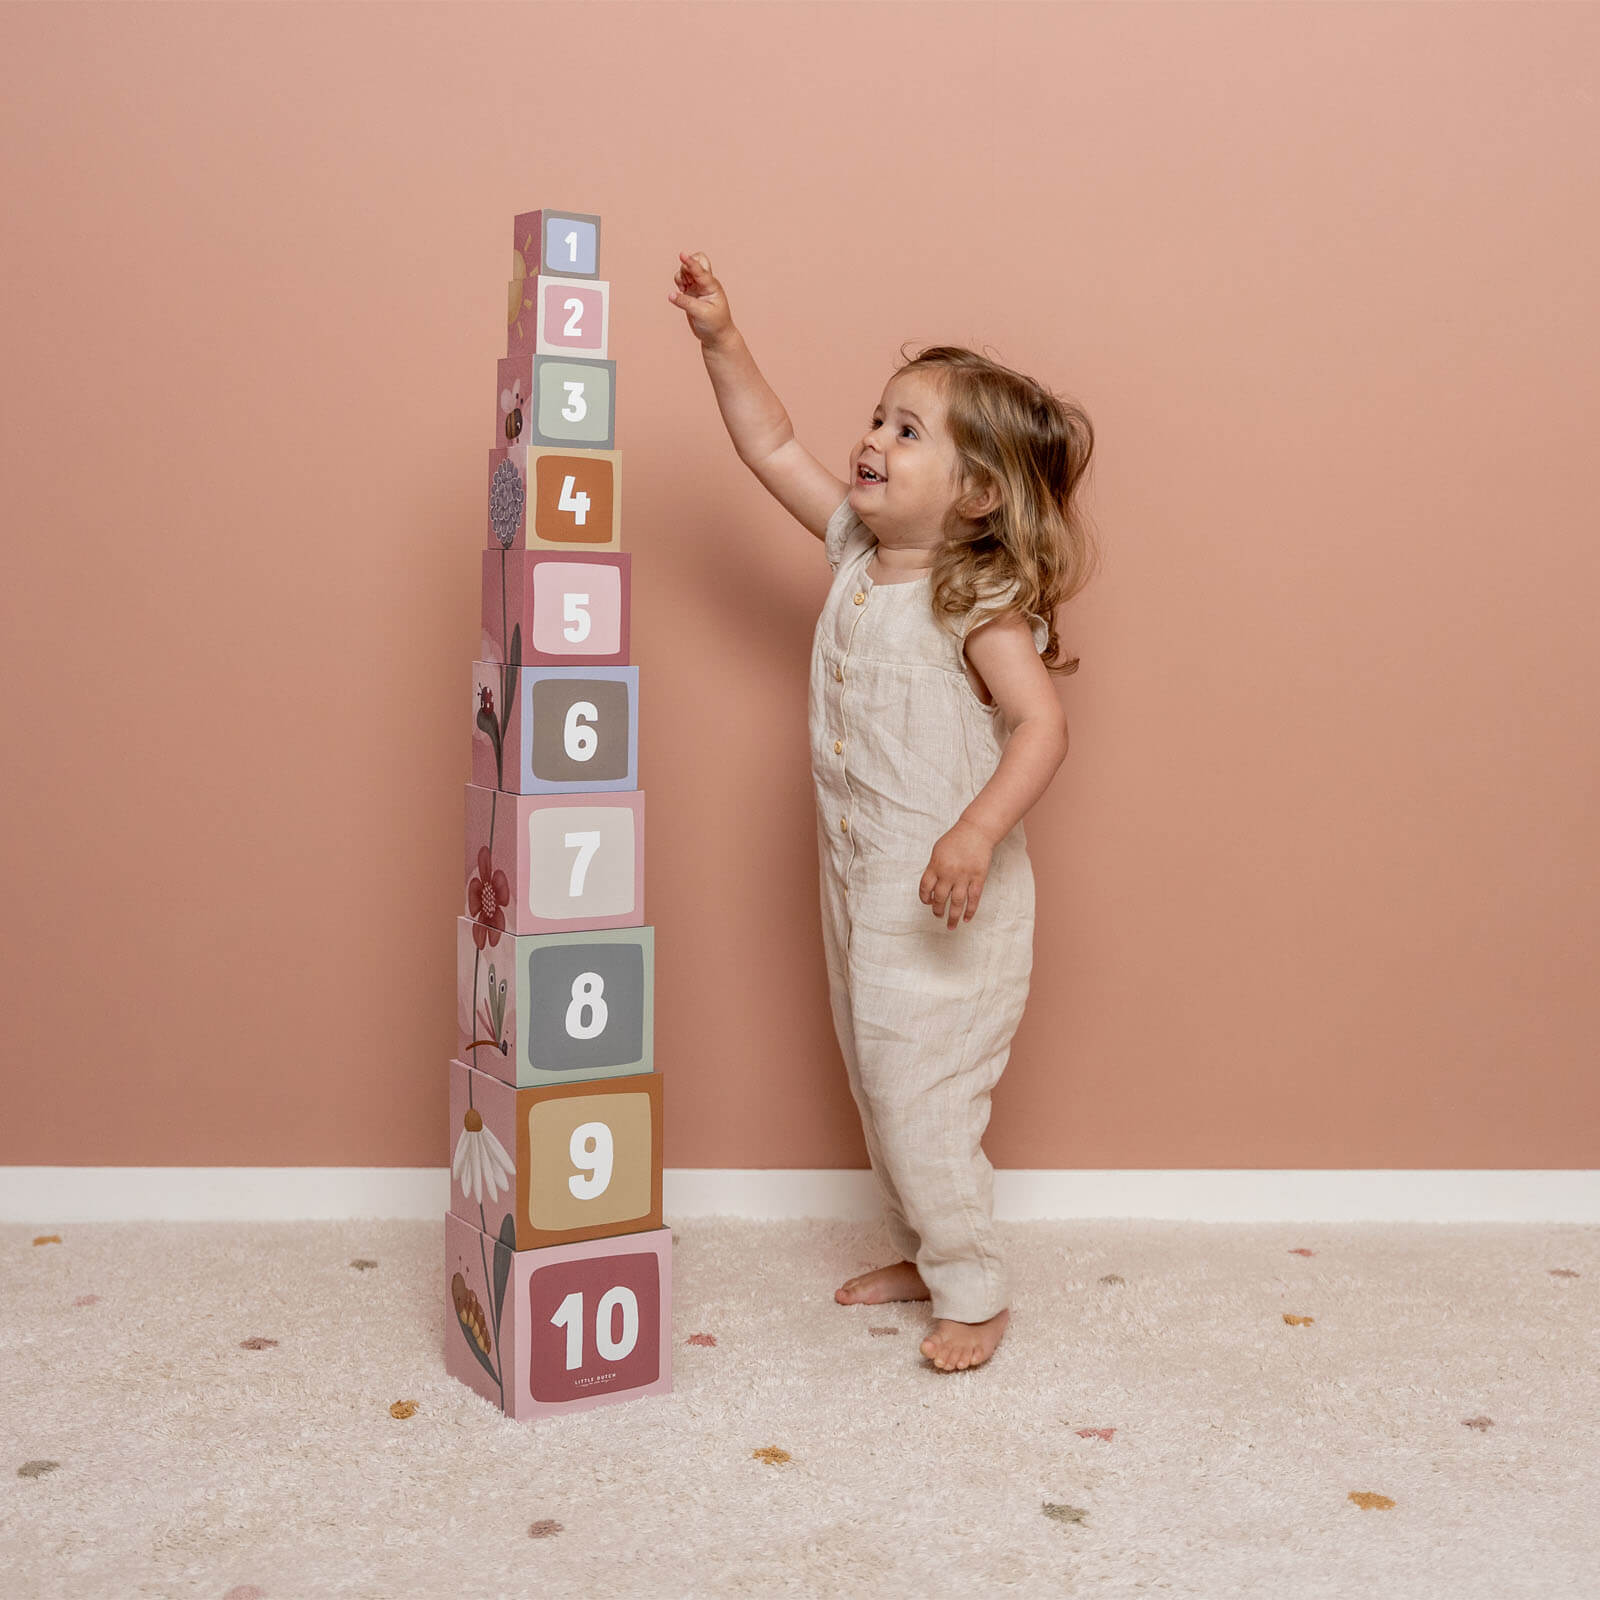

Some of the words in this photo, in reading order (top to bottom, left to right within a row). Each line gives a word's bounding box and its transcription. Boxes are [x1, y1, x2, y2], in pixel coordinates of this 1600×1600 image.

[563, 231, 578, 262] 1
[563, 298, 584, 337] 2
[561, 381, 587, 422] 3
[557, 475, 591, 526] 4
[563, 593, 592, 643] 5
[563, 701, 599, 762] 6
[564, 831, 601, 898] 7
[565, 972, 609, 1040] 8
[568, 1122, 613, 1201] 9
[551, 1286, 639, 1371] 10
[574, 1376, 594, 1385] LITTLE
[596, 1372, 616, 1380] DUTCH
